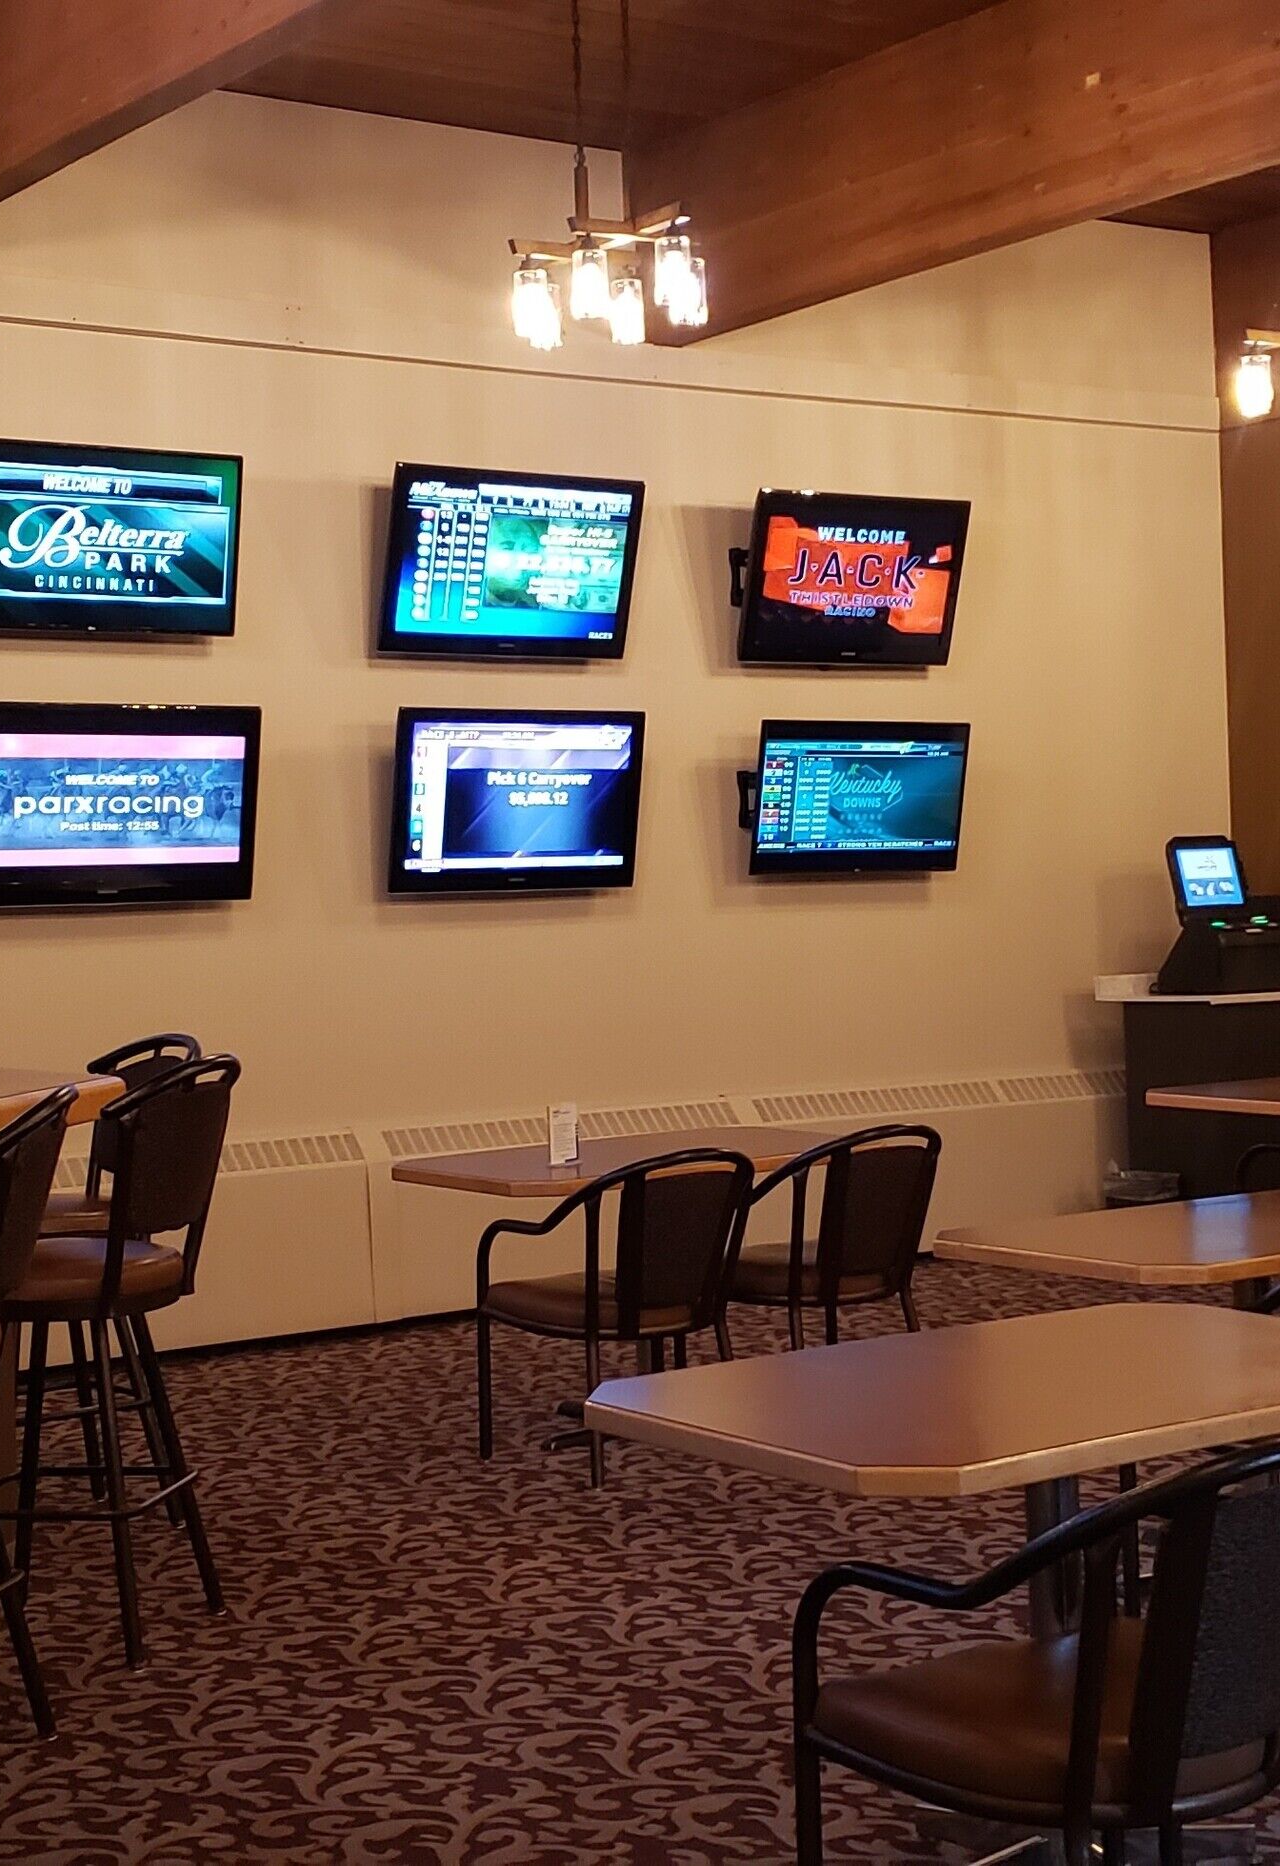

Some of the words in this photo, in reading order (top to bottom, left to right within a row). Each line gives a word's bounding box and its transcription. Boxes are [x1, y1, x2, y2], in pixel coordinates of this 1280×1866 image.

[42, 472, 109, 494] WELCOME
[111, 477, 133, 495] TO
[817, 526, 907, 544] WELCOME
[83, 550, 172, 574] PARK
[34, 573, 155, 592] CINCINNATI
[789, 590, 915, 609] THISTLEDOWN
[419, 766, 424, 776] 2
[487, 770, 517, 786] Pick
[528, 771, 593, 789] Carryover
[65, 774, 138, 787] WELCOME
[139, 774, 160, 787] TO
[829, 770, 902, 804] Kentucky
[416, 804, 422, 813] 4
[843, 797, 882, 808] DOWNS
[59, 820, 91, 832] Post
[92, 820, 123, 832] time:
[126, 821, 160, 832] 12:55
